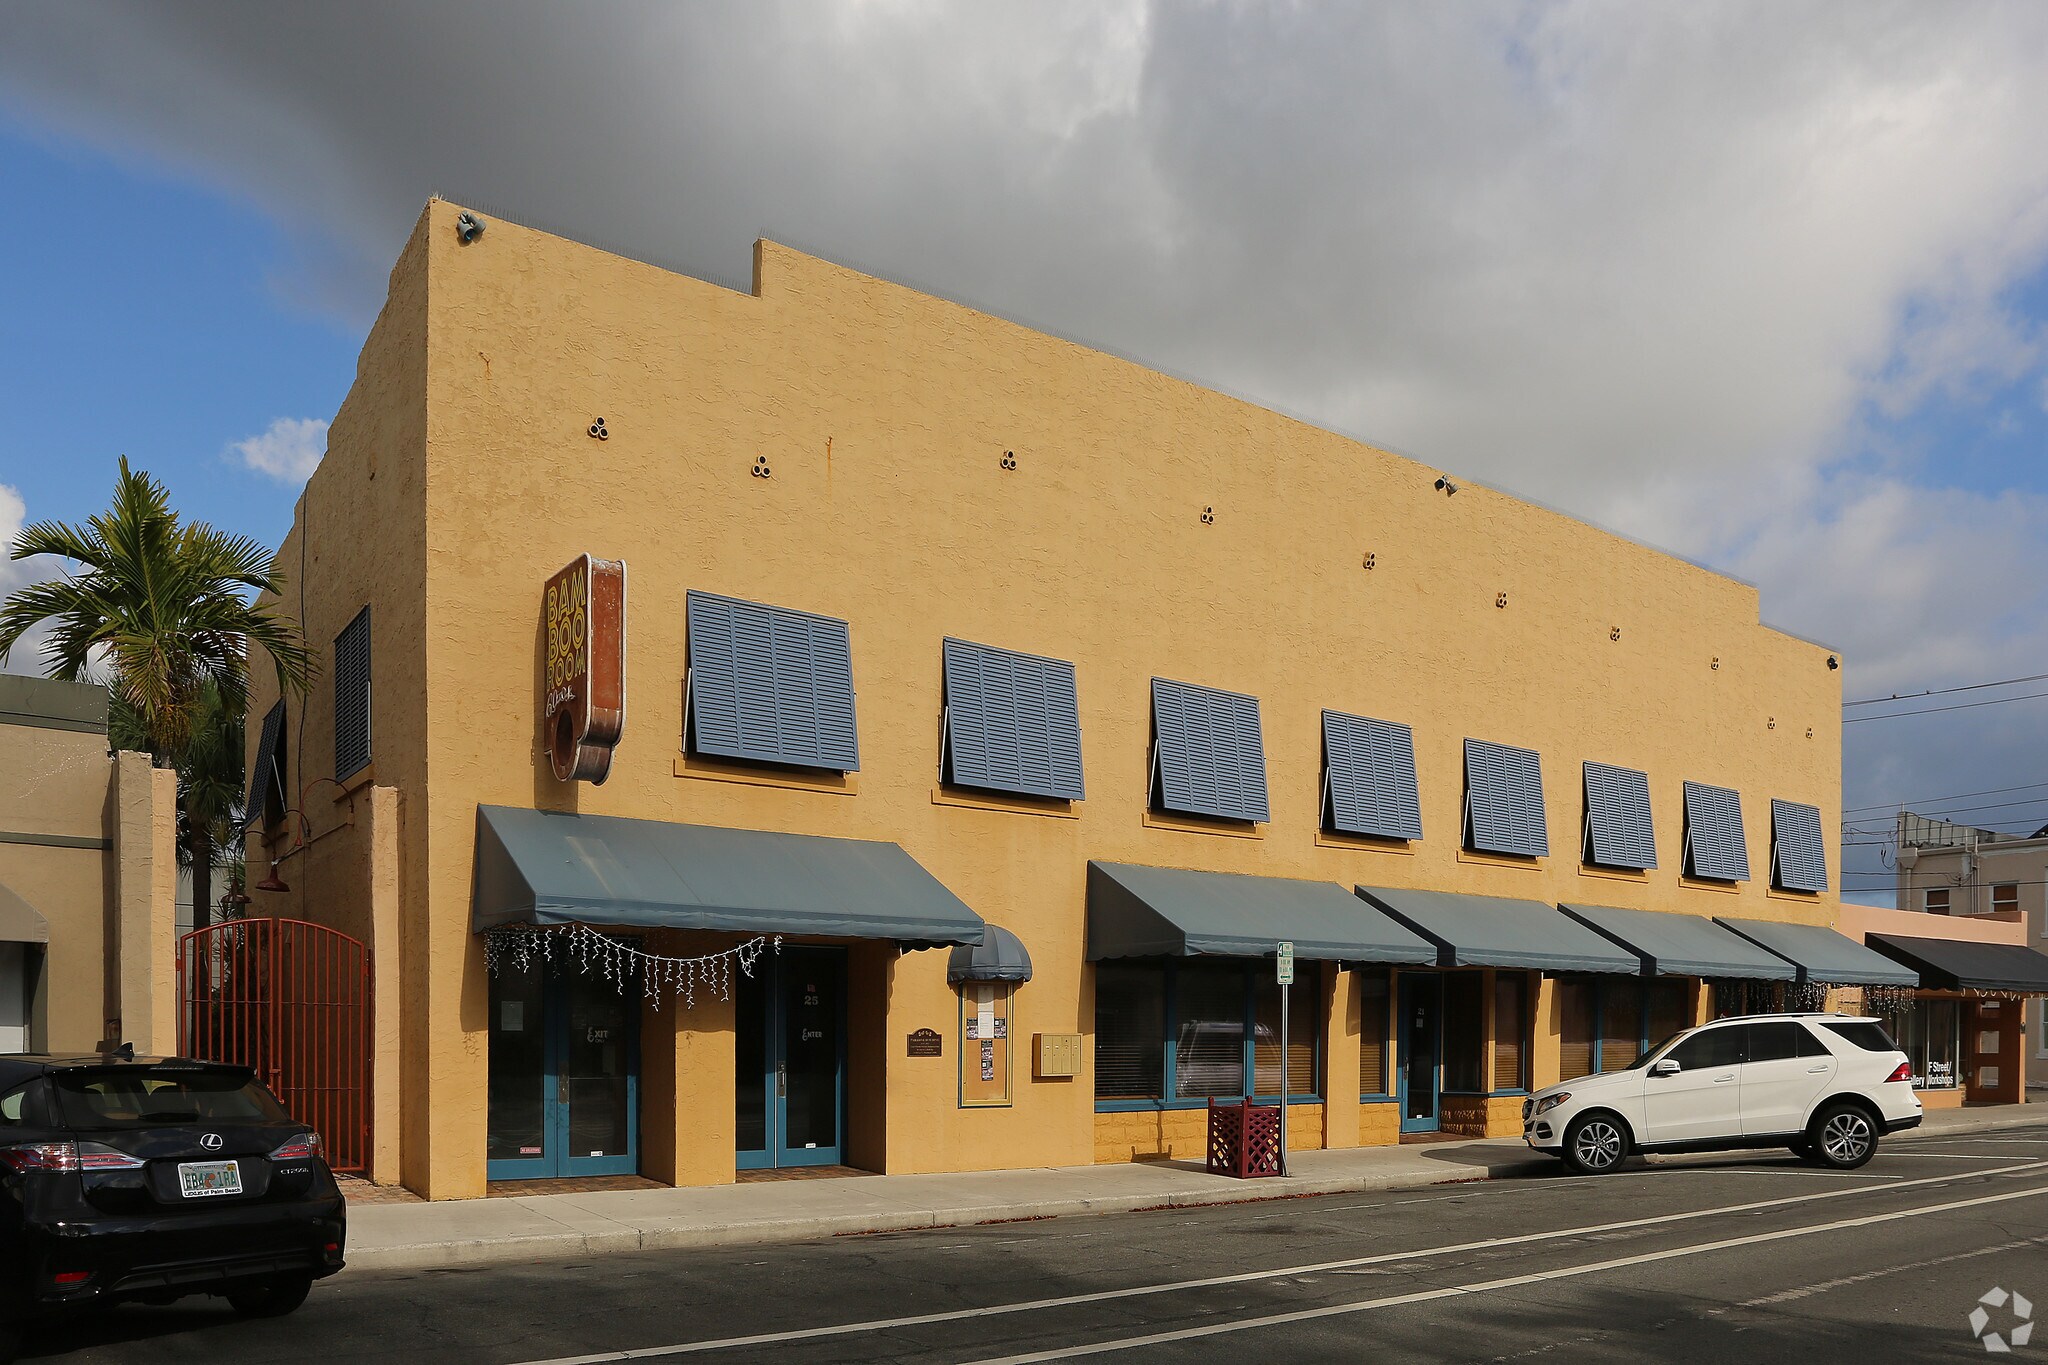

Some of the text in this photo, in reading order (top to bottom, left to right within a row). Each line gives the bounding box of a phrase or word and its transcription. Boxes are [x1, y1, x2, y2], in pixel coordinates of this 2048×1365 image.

[548, 566, 586, 627] BAM
[548, 607, 586, 664] BOO
[547, 646, 586, 693] ROOM
